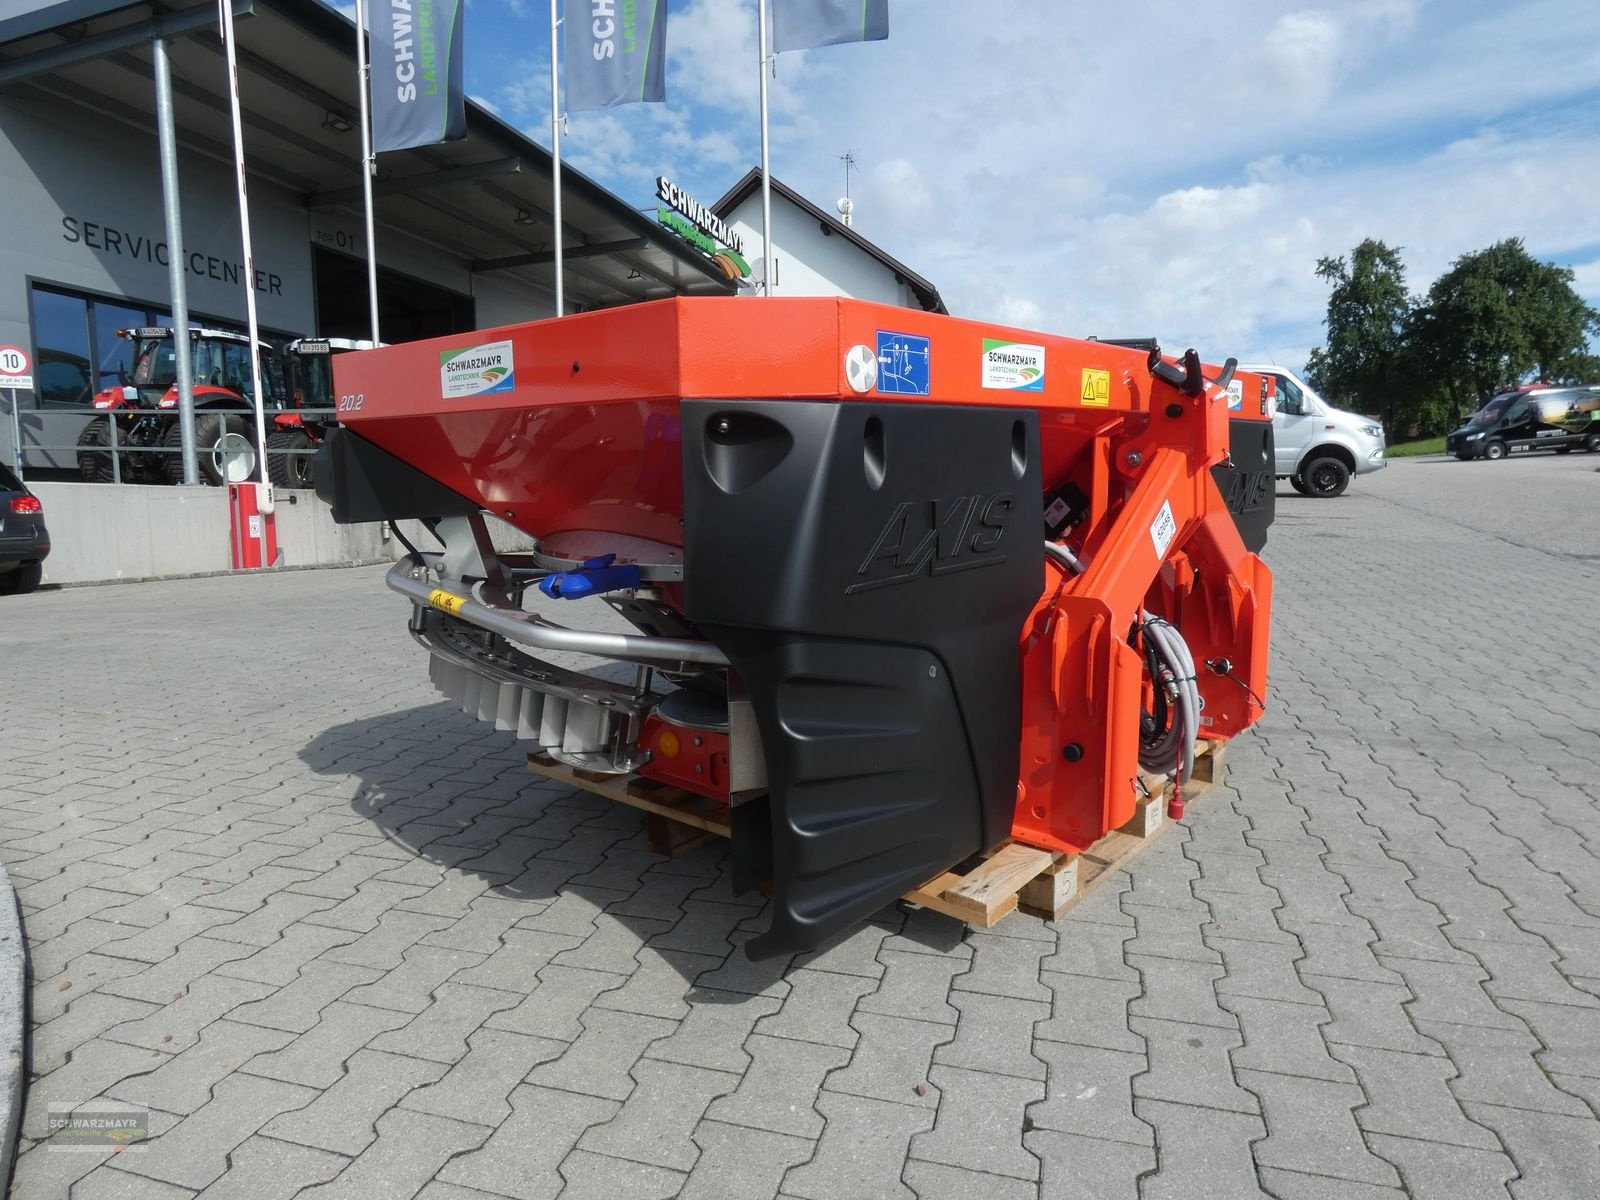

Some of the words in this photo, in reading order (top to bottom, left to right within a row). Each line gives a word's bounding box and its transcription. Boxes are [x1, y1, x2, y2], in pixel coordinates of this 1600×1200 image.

[657, 176, 744, 255] SCHWARZMAYR
[62, 216, 282, 297] SERVICCENER
[3, 354, 19, 368] 10
[447, 355, 502, 373] SCHWARZMAYR
[988, 352, 1037, 366] SCHWARZMAYR
[449, 372, 480, 382] LANDTECHNIK
[339, 394, 364, 411] 20.2
[856, 493, 1013, 577] AXIS
